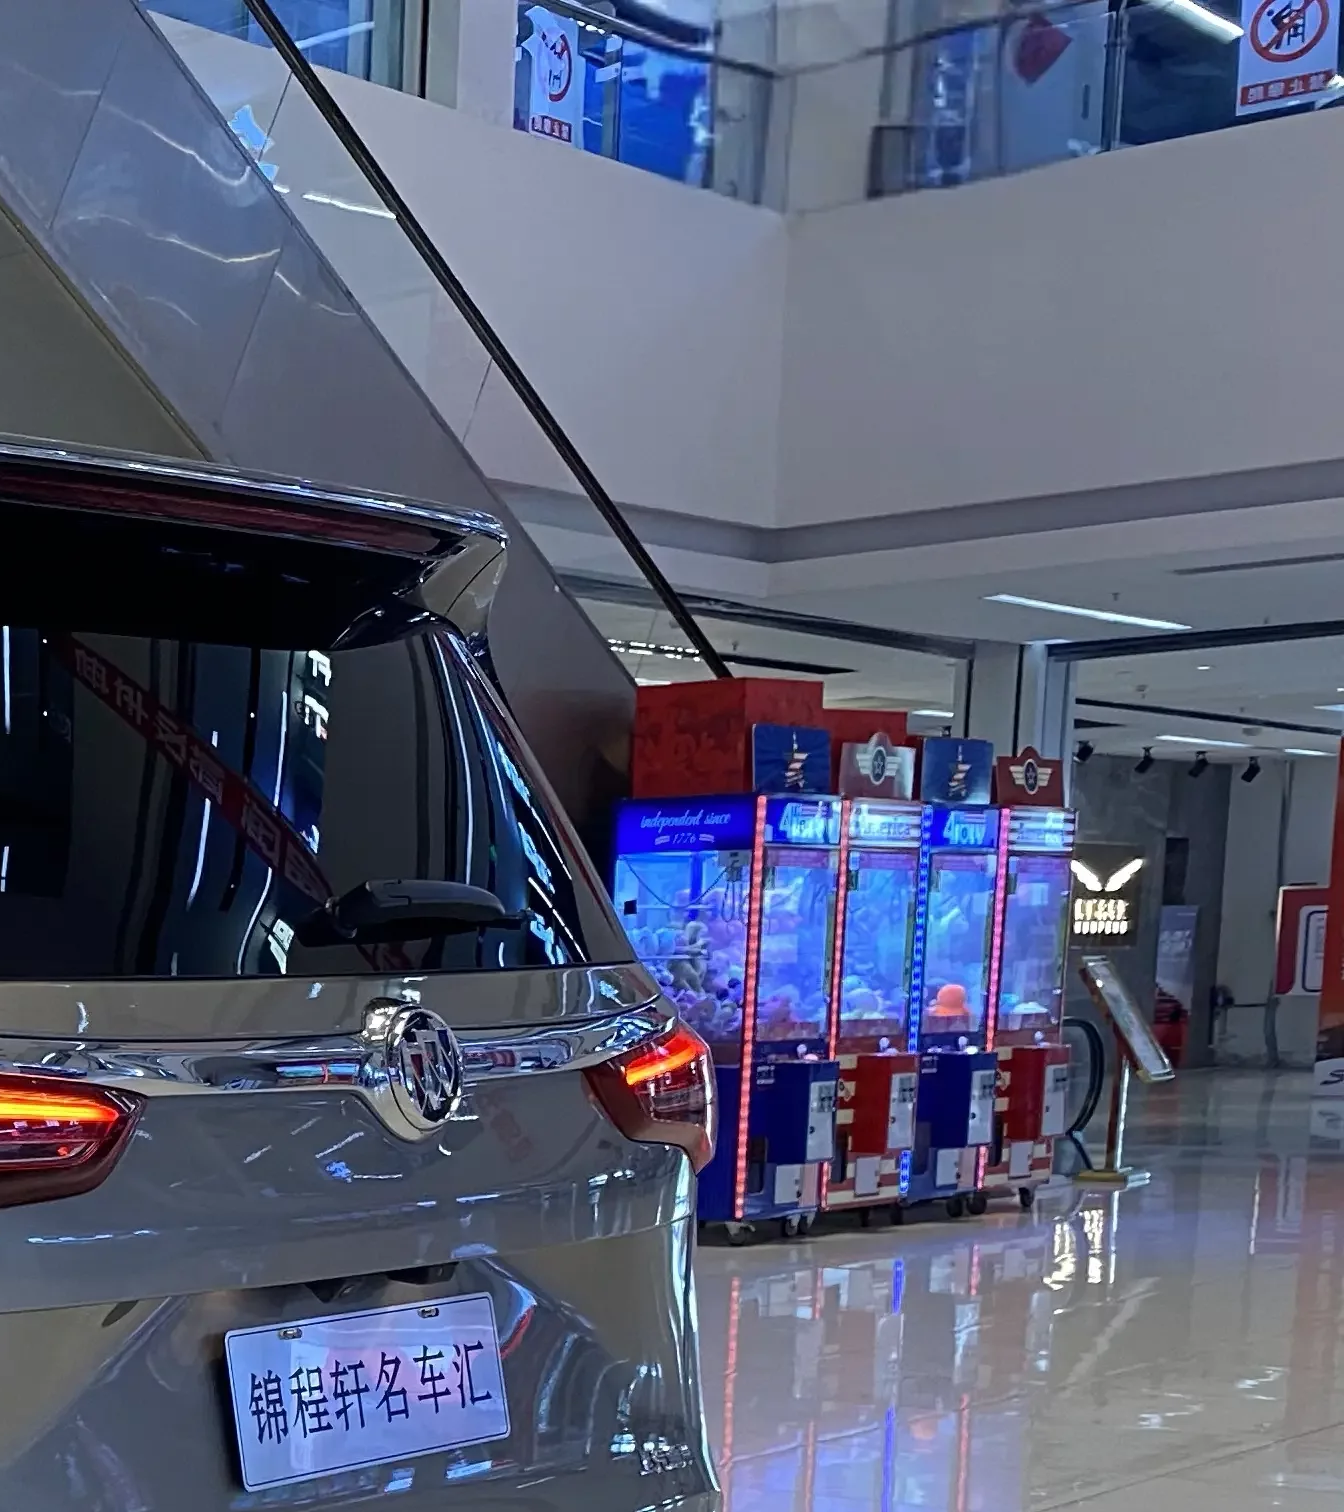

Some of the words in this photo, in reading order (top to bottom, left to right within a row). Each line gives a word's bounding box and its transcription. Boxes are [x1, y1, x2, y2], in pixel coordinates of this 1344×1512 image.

[703, 812, 731, 825] since
[672, 832, 697, 844] 1776
[249, 1340, 493, 1445] 锦程轩名车汇
